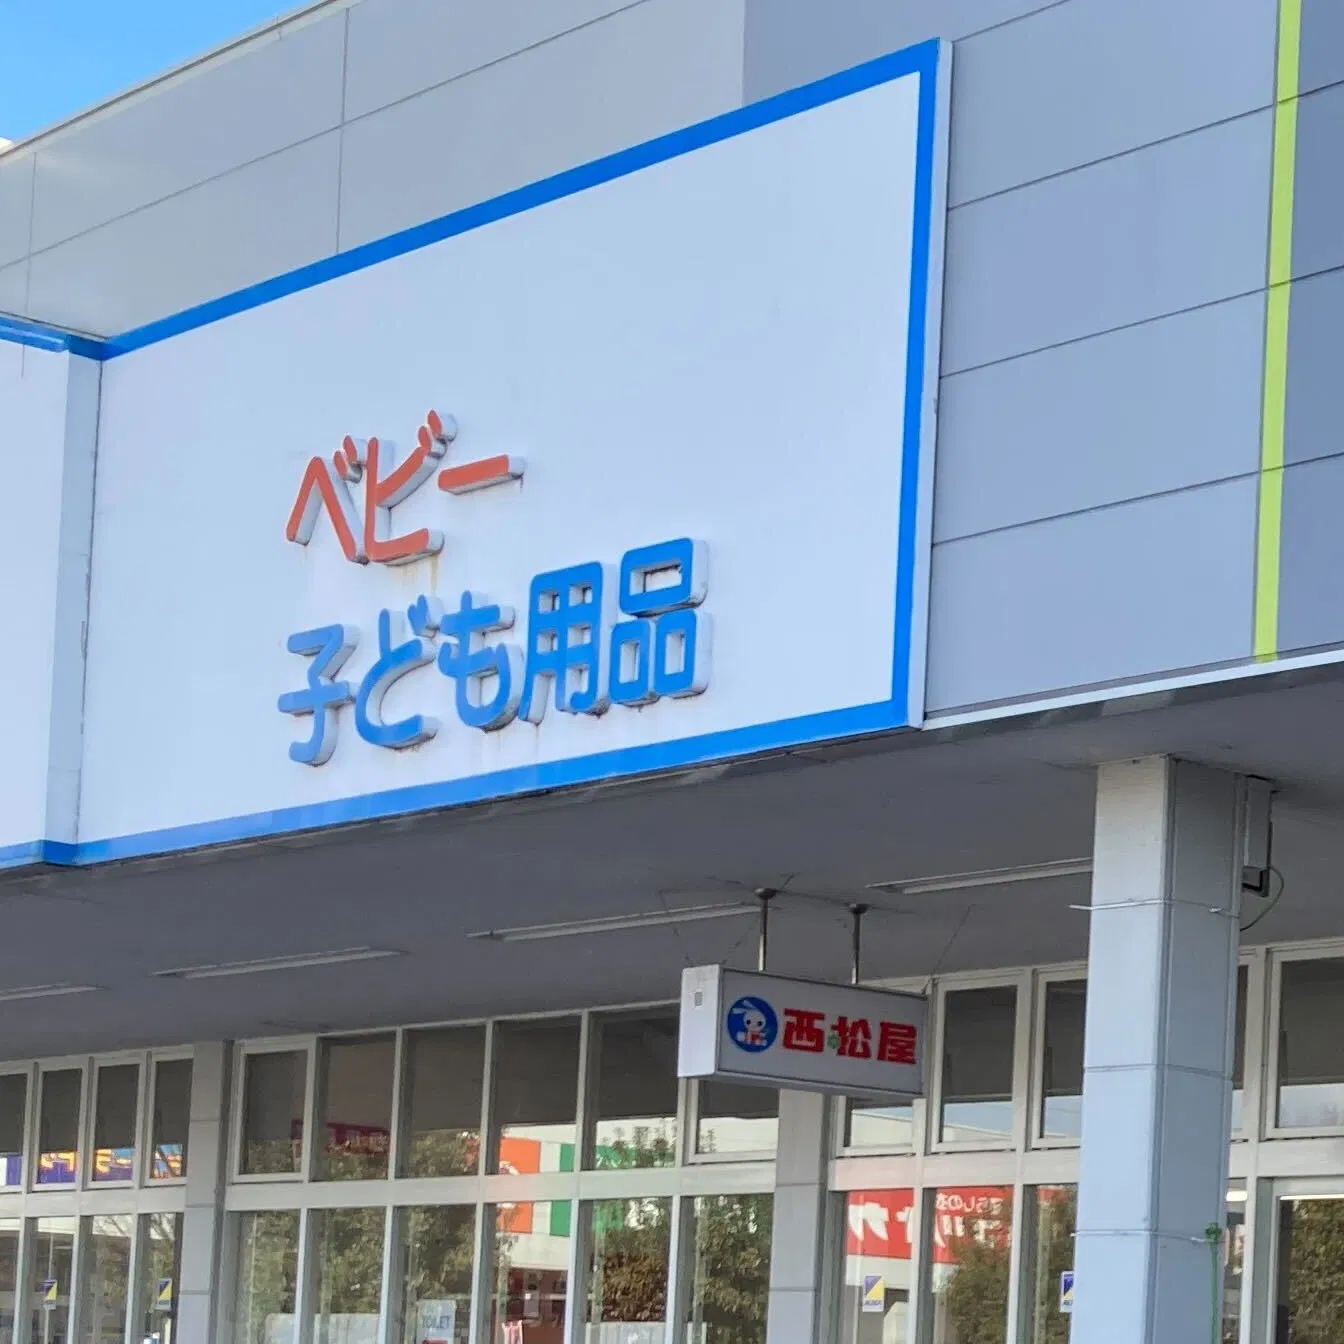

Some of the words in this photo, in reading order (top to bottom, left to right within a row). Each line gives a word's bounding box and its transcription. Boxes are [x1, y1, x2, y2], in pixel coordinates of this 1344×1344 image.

[286, 409, 524, 565] ベビー
[278, 537, 709, 766] 子ども用品
[783, 1008, 917, 1064] 西松屋
